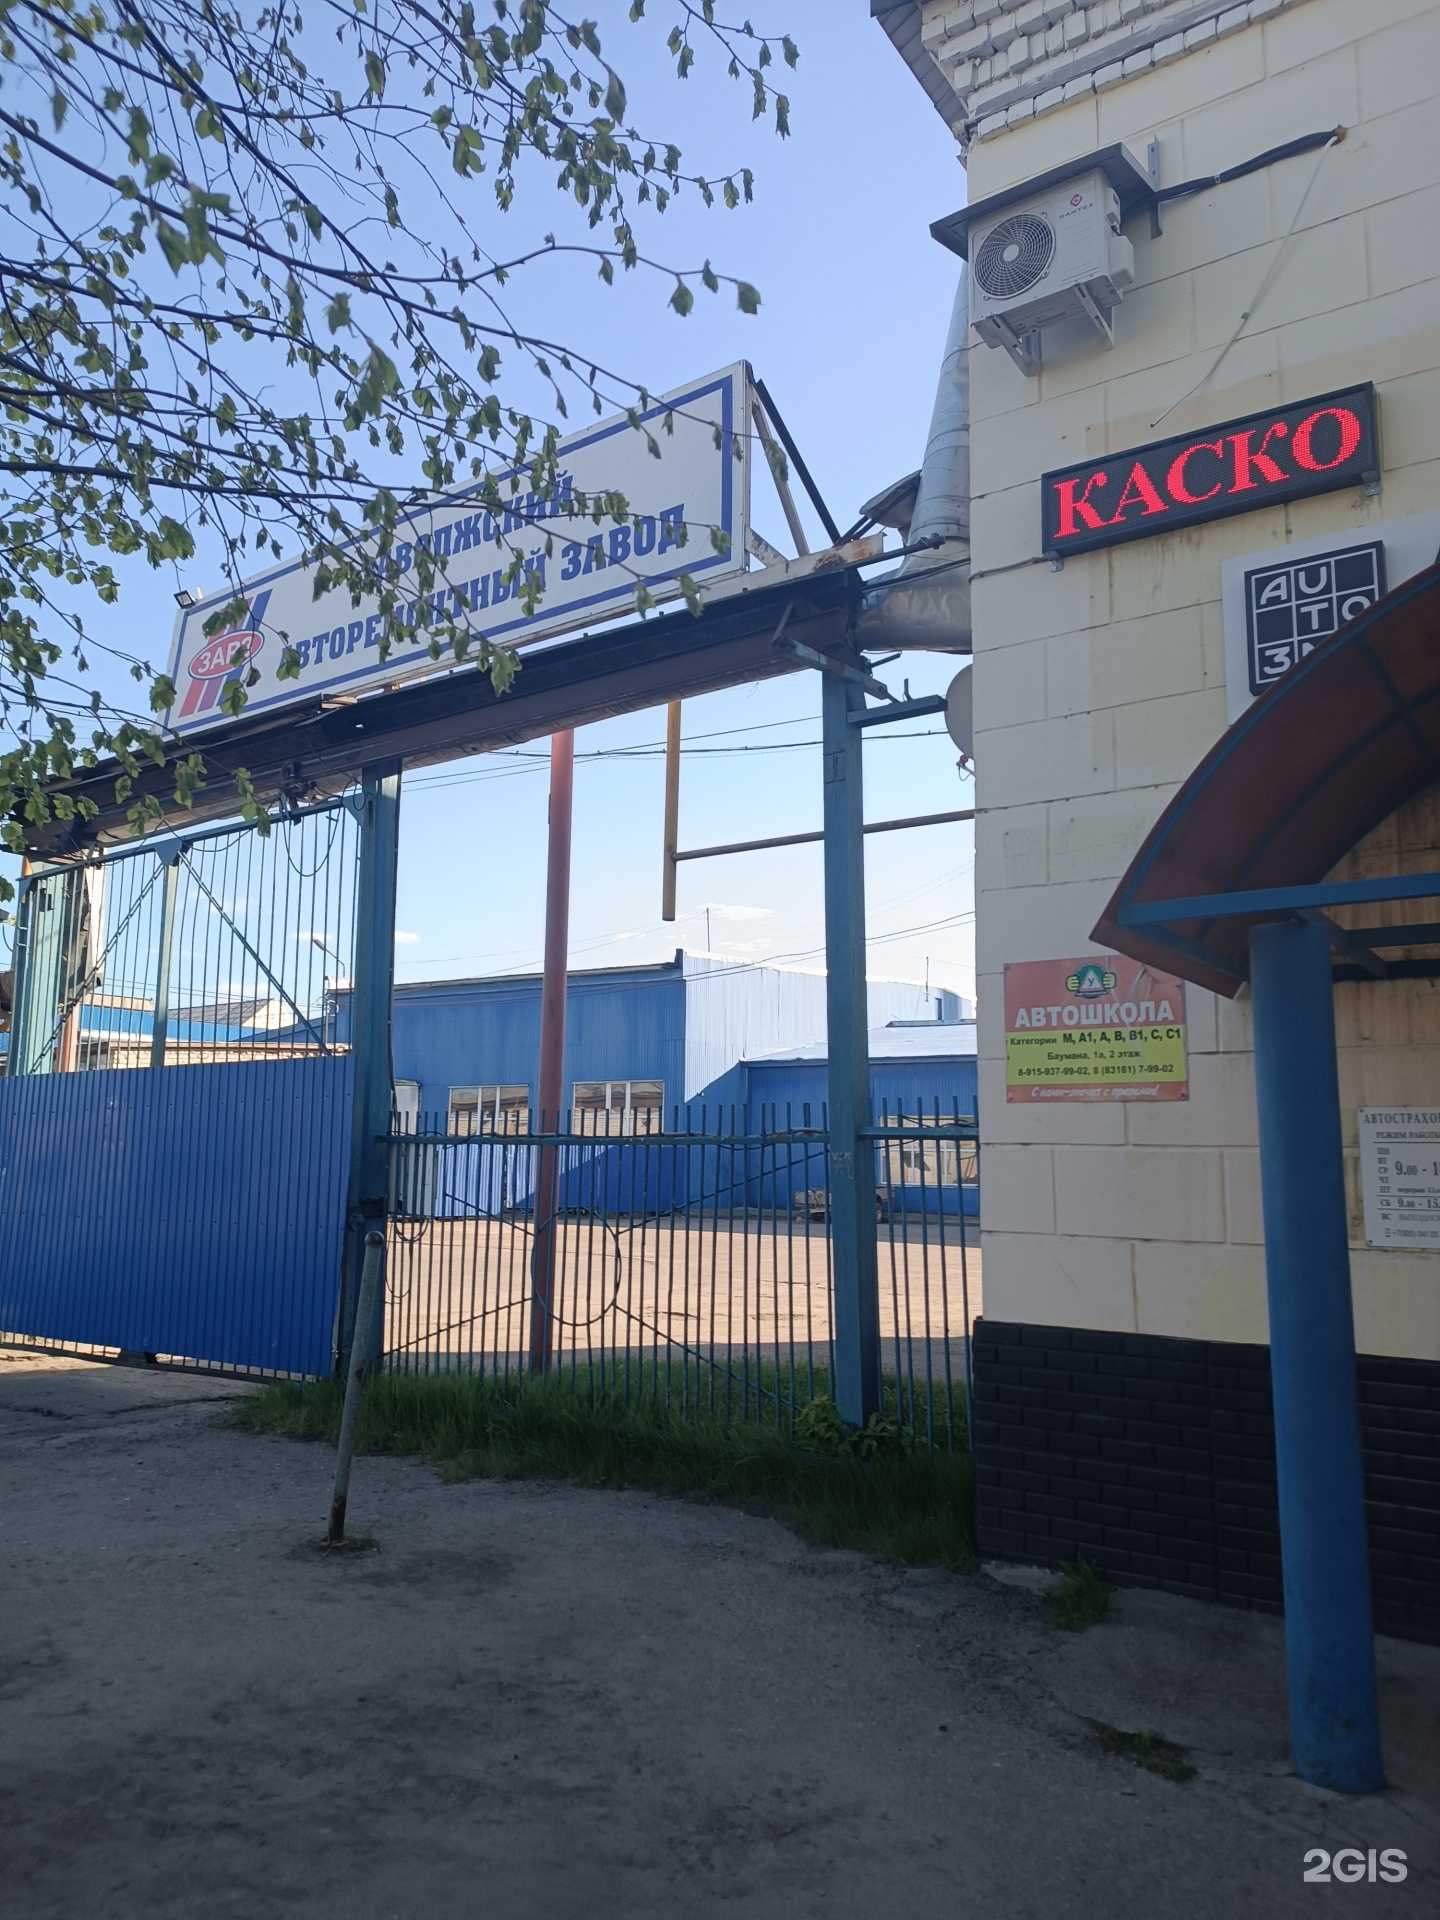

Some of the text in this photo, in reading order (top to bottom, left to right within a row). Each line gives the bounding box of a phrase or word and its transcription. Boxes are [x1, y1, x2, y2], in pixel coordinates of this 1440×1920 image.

[1054, 407, 1361, 539] КАСКО
[560, 503, 685, 581] ЗАВОД
[1014, 1000, 1174, 1028] АВТОШКОЛА
[1009, 1037, 1057, 1047] Категории
[1108, 1049, 1115, 1059] 2
